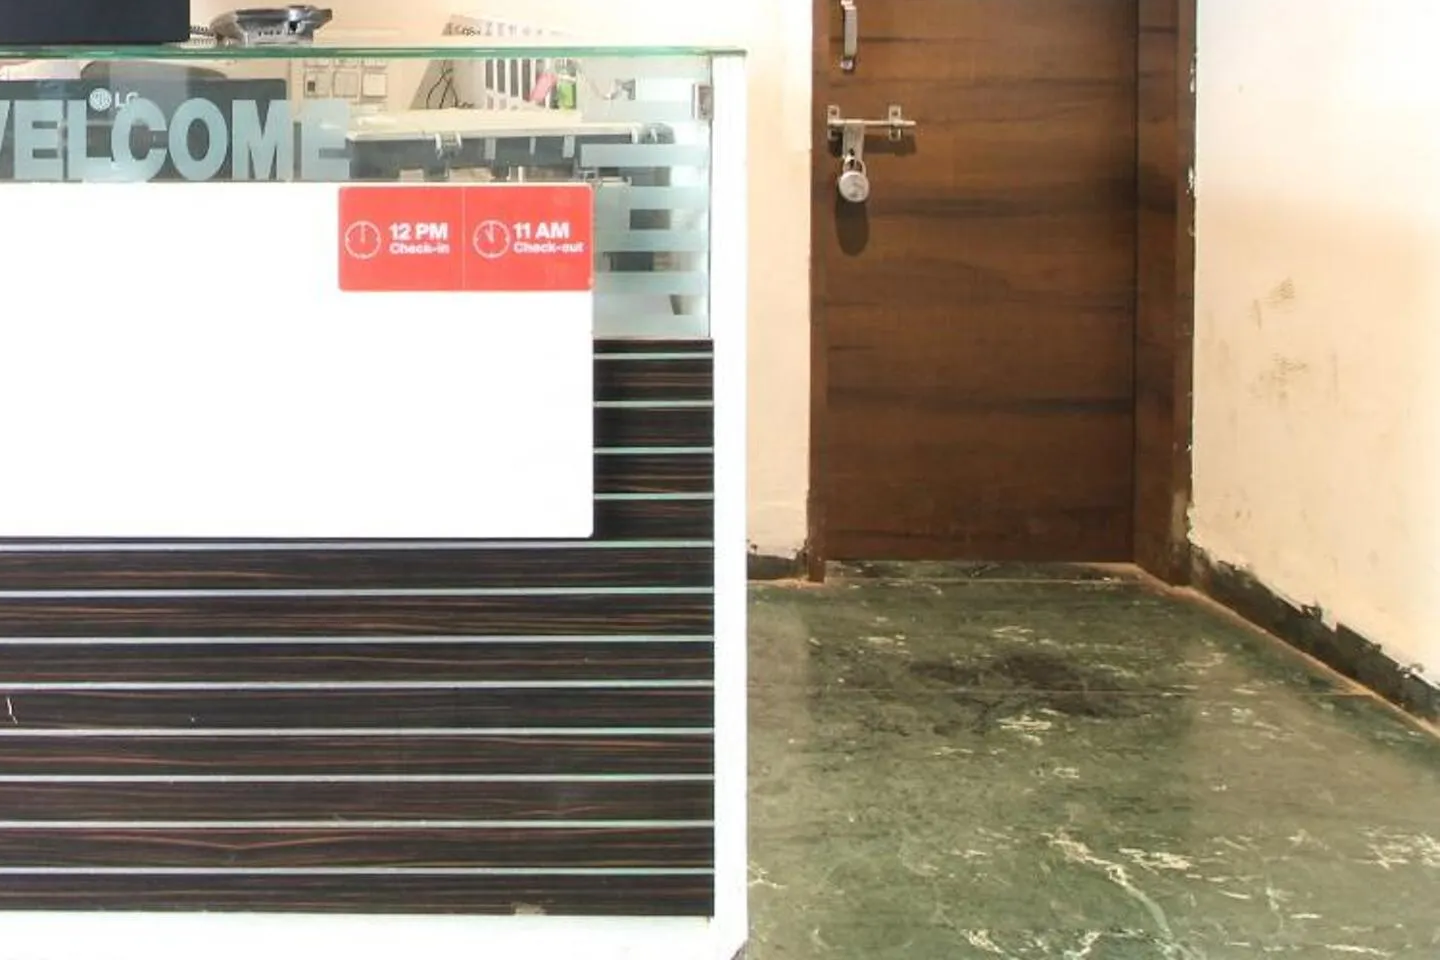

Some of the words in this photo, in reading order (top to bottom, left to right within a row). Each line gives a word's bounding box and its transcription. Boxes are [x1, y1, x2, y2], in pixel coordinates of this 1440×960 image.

[388, 222, 411, 241] 12
[416, 222, 449, 241] PM
[512, 222, 531, 240] 11
[536, 222, 570, 239] AM
[388, 242, 450, 255] Check-in
[513, 241, 584, 254] Check-out
